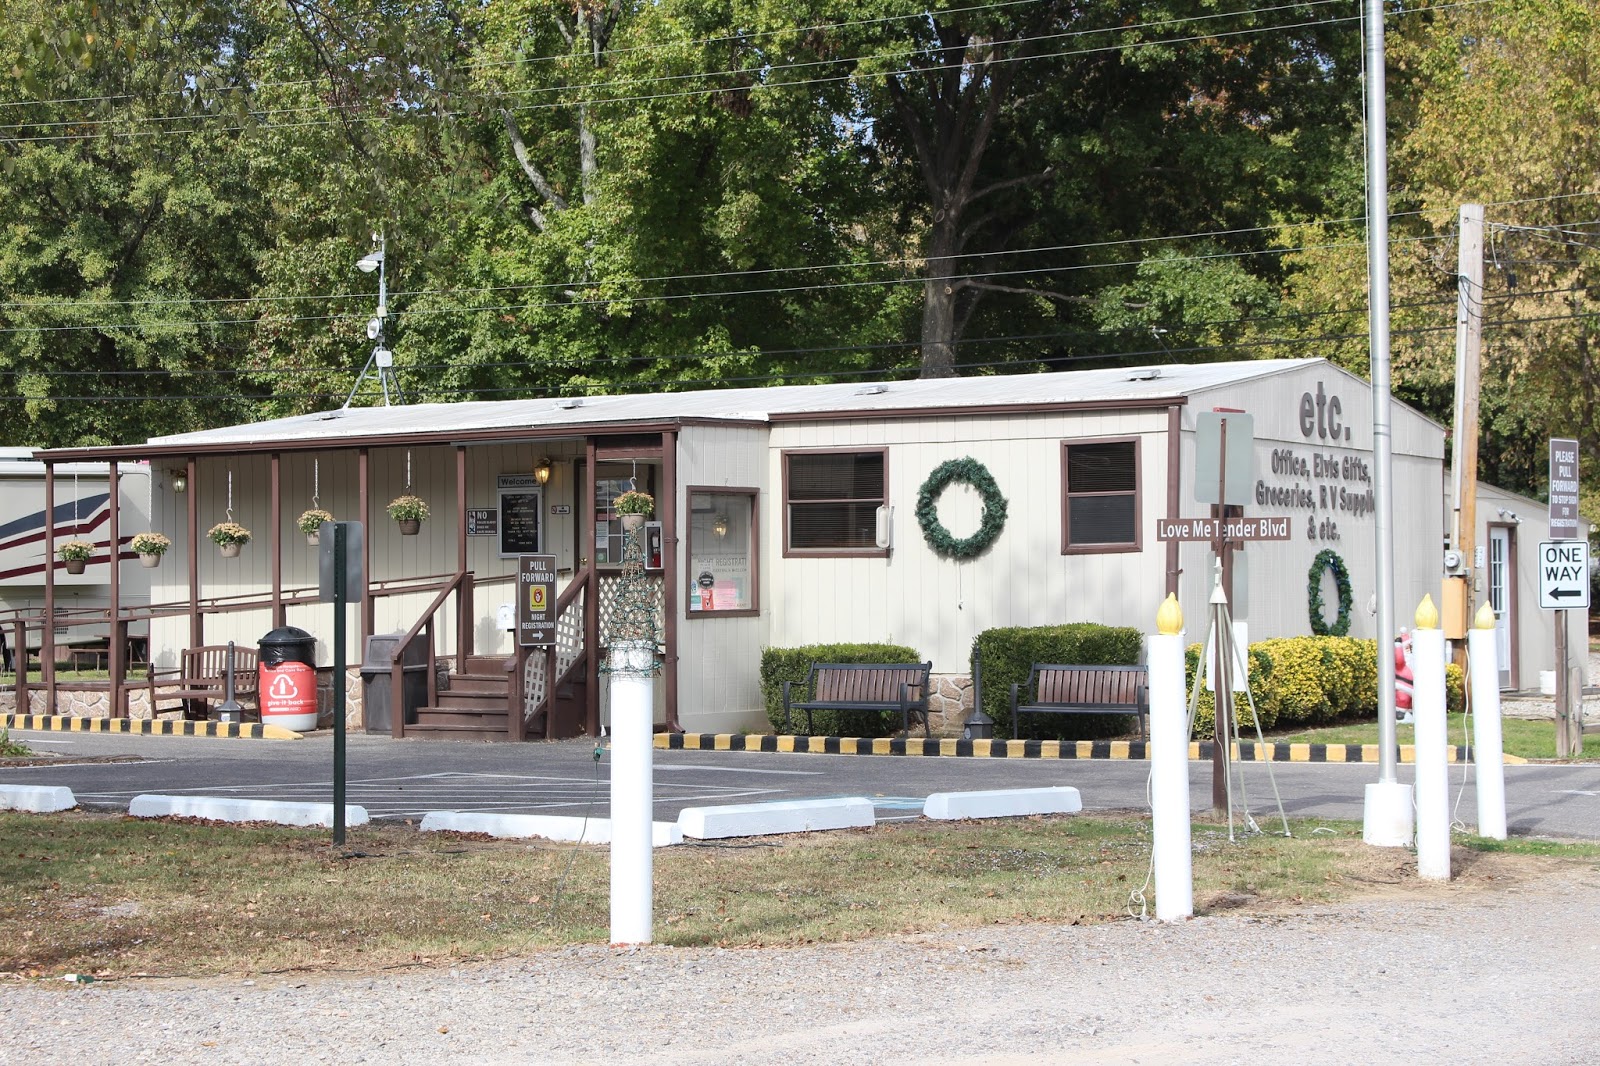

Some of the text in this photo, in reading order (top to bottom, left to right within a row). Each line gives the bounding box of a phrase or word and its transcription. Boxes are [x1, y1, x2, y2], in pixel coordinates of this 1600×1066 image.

[1299, 381, 1351, 441] etc.
[1555, 450, 1575, 463] PLEASE
[1271, 448, 1371, 487] Office, Elvis Gifts,
[1559, 465, 1572, 477] PULL
[1552, 480, 1577, 492] FORWARD
[1255, 479, 1375, 517] Groceries, R V Suppli
[1552, 495, 1558, 504] TO
[477, 511, 487, 520] NO
[1160, 518, 1287, 538] Love Me Tender Blvd
[1307, 515, 1340, 540] & etc.
[1551, 519, 1577, 528] REGISTRATION
[1545, 547, 1582, 564] ONE
[529, 561, 547, 571] PULL
[521, 572, 554, 583] FORWARD
[1545, 566, 1582, 583] WAY
[531, 613, 546, 621] NIGHT
[521, 622, 555, 630] REGISTRATION
